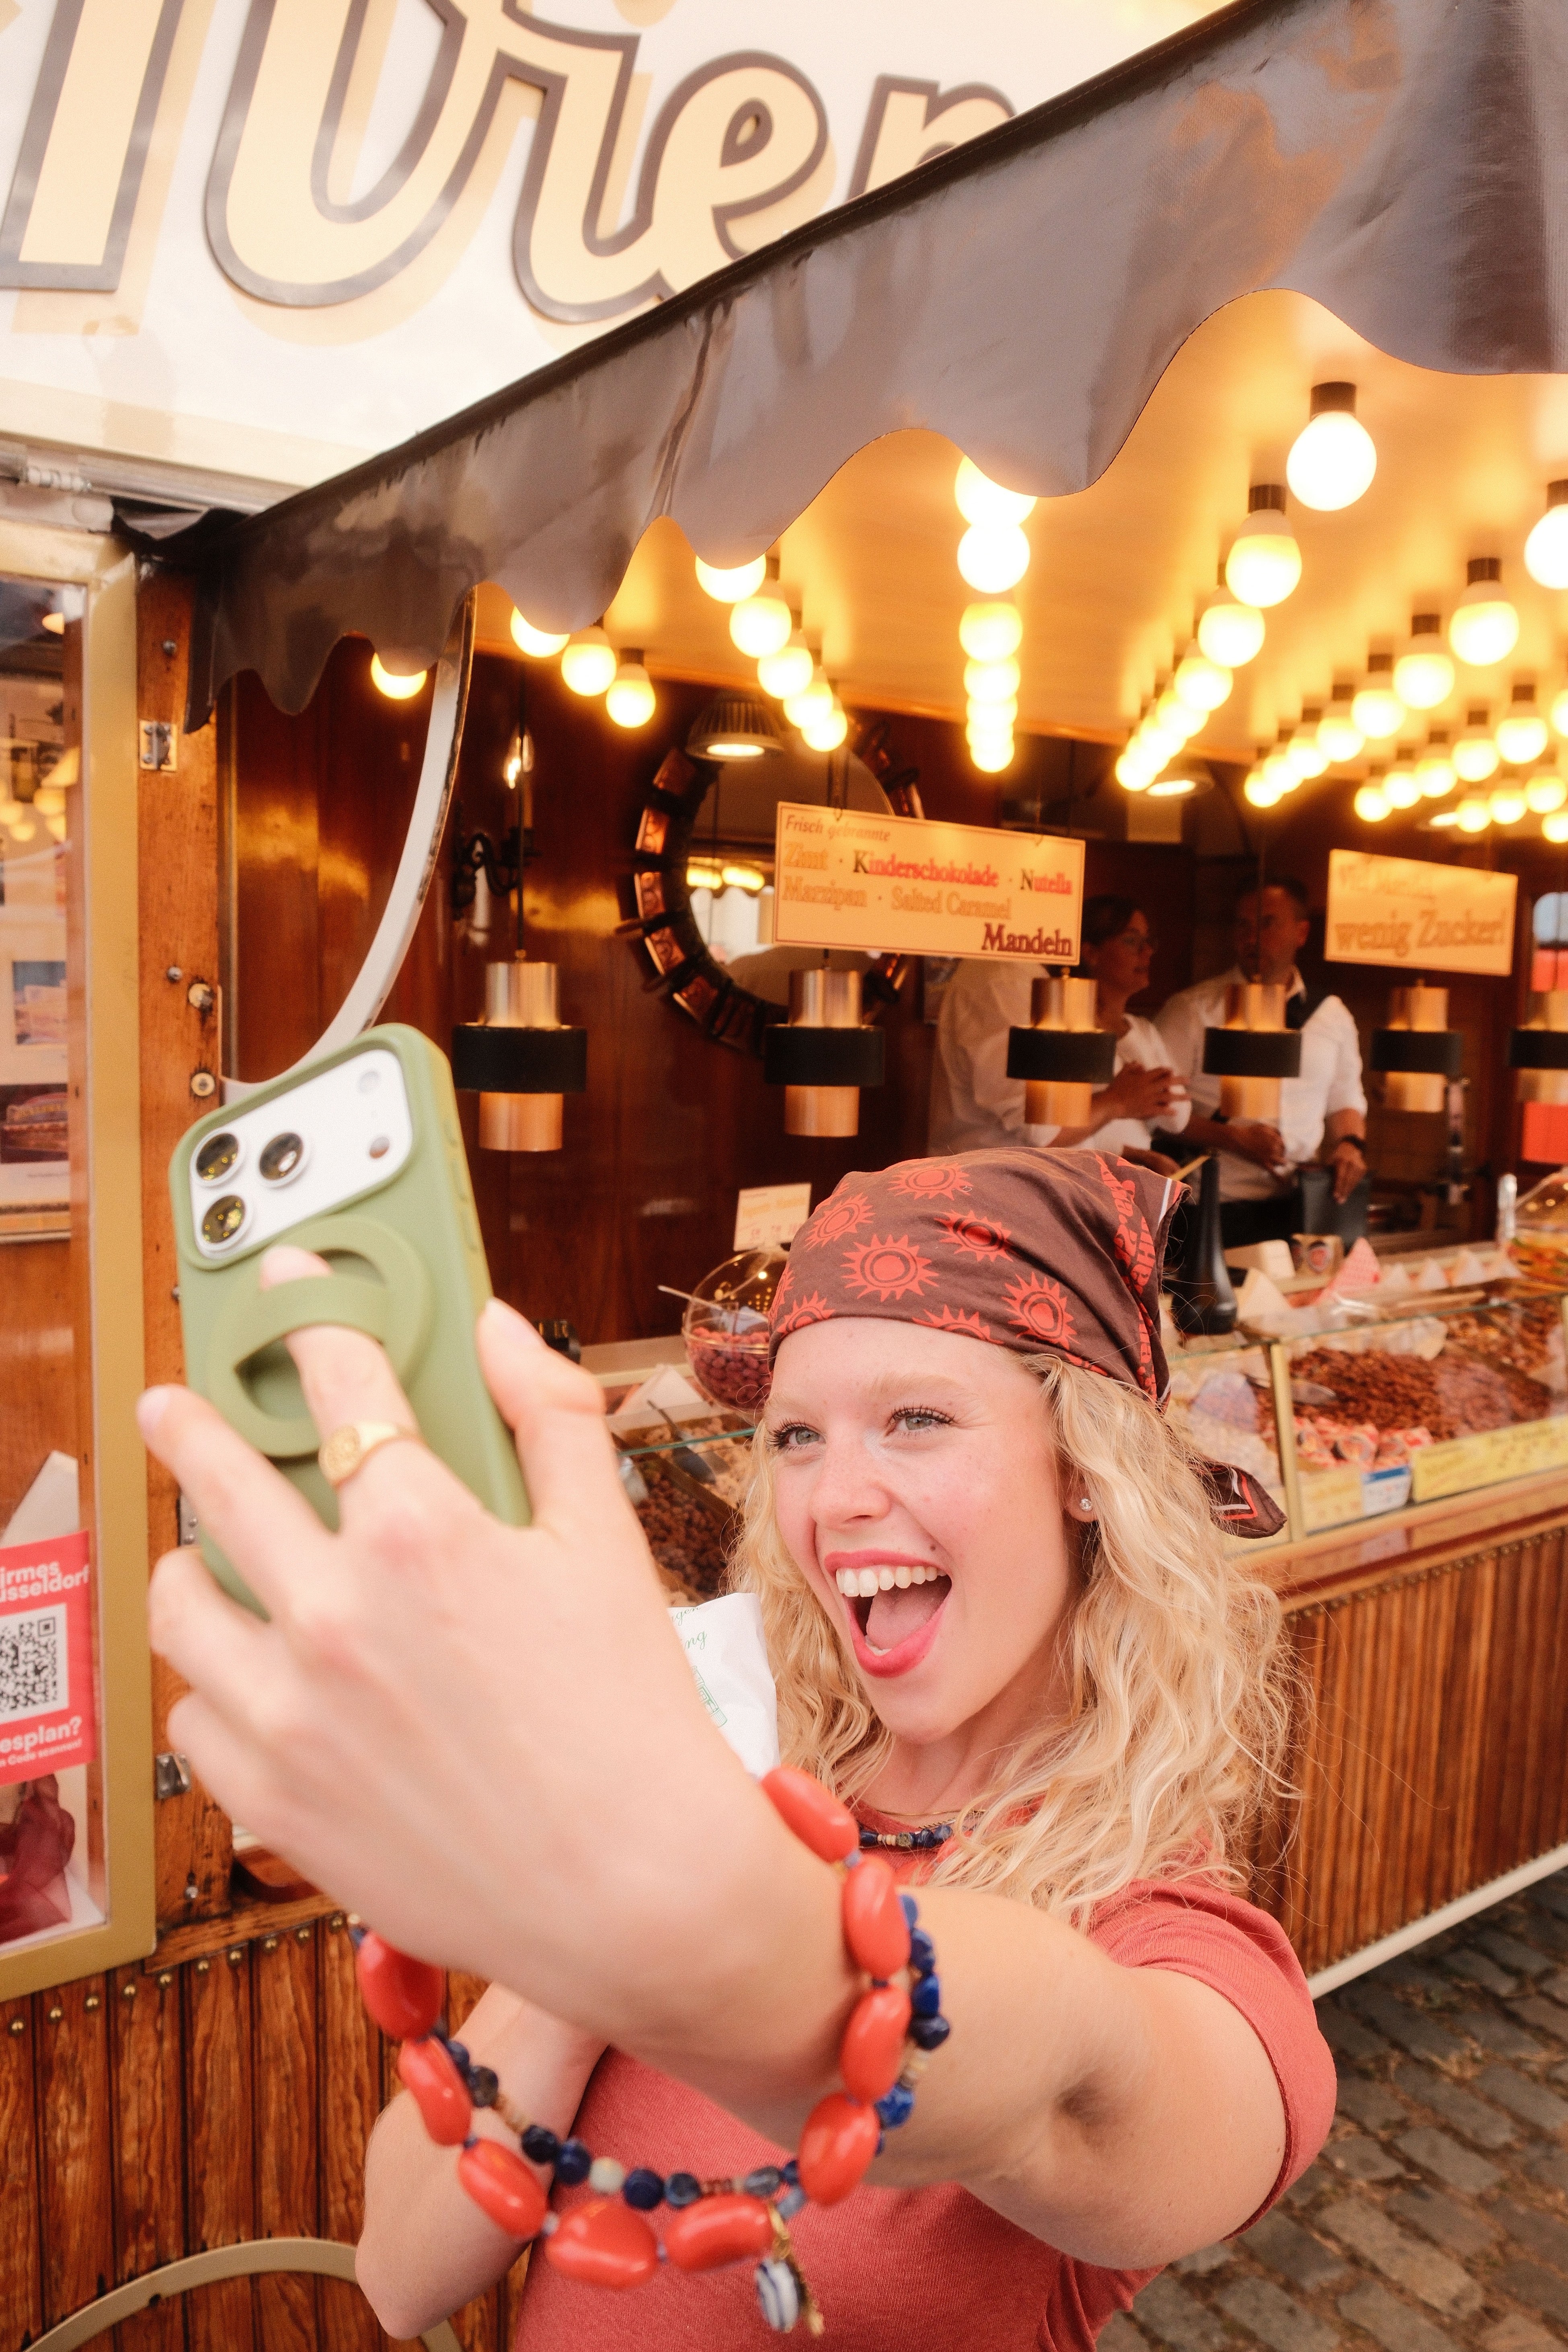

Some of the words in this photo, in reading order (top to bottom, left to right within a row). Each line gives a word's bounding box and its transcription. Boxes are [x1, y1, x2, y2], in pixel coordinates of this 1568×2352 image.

[785, 814, 824, 835] Frisch
[828, 819, 891, 842] gebrannte
[852, 849, 1000, 888] Kinderschokolade
[1020, 868, 1073, 896] Nutella
[891, 886, 942, 914] Salted
[946, 891, 1012, 920] Caramel
[981, 922, 1073, 957] Mandeln
